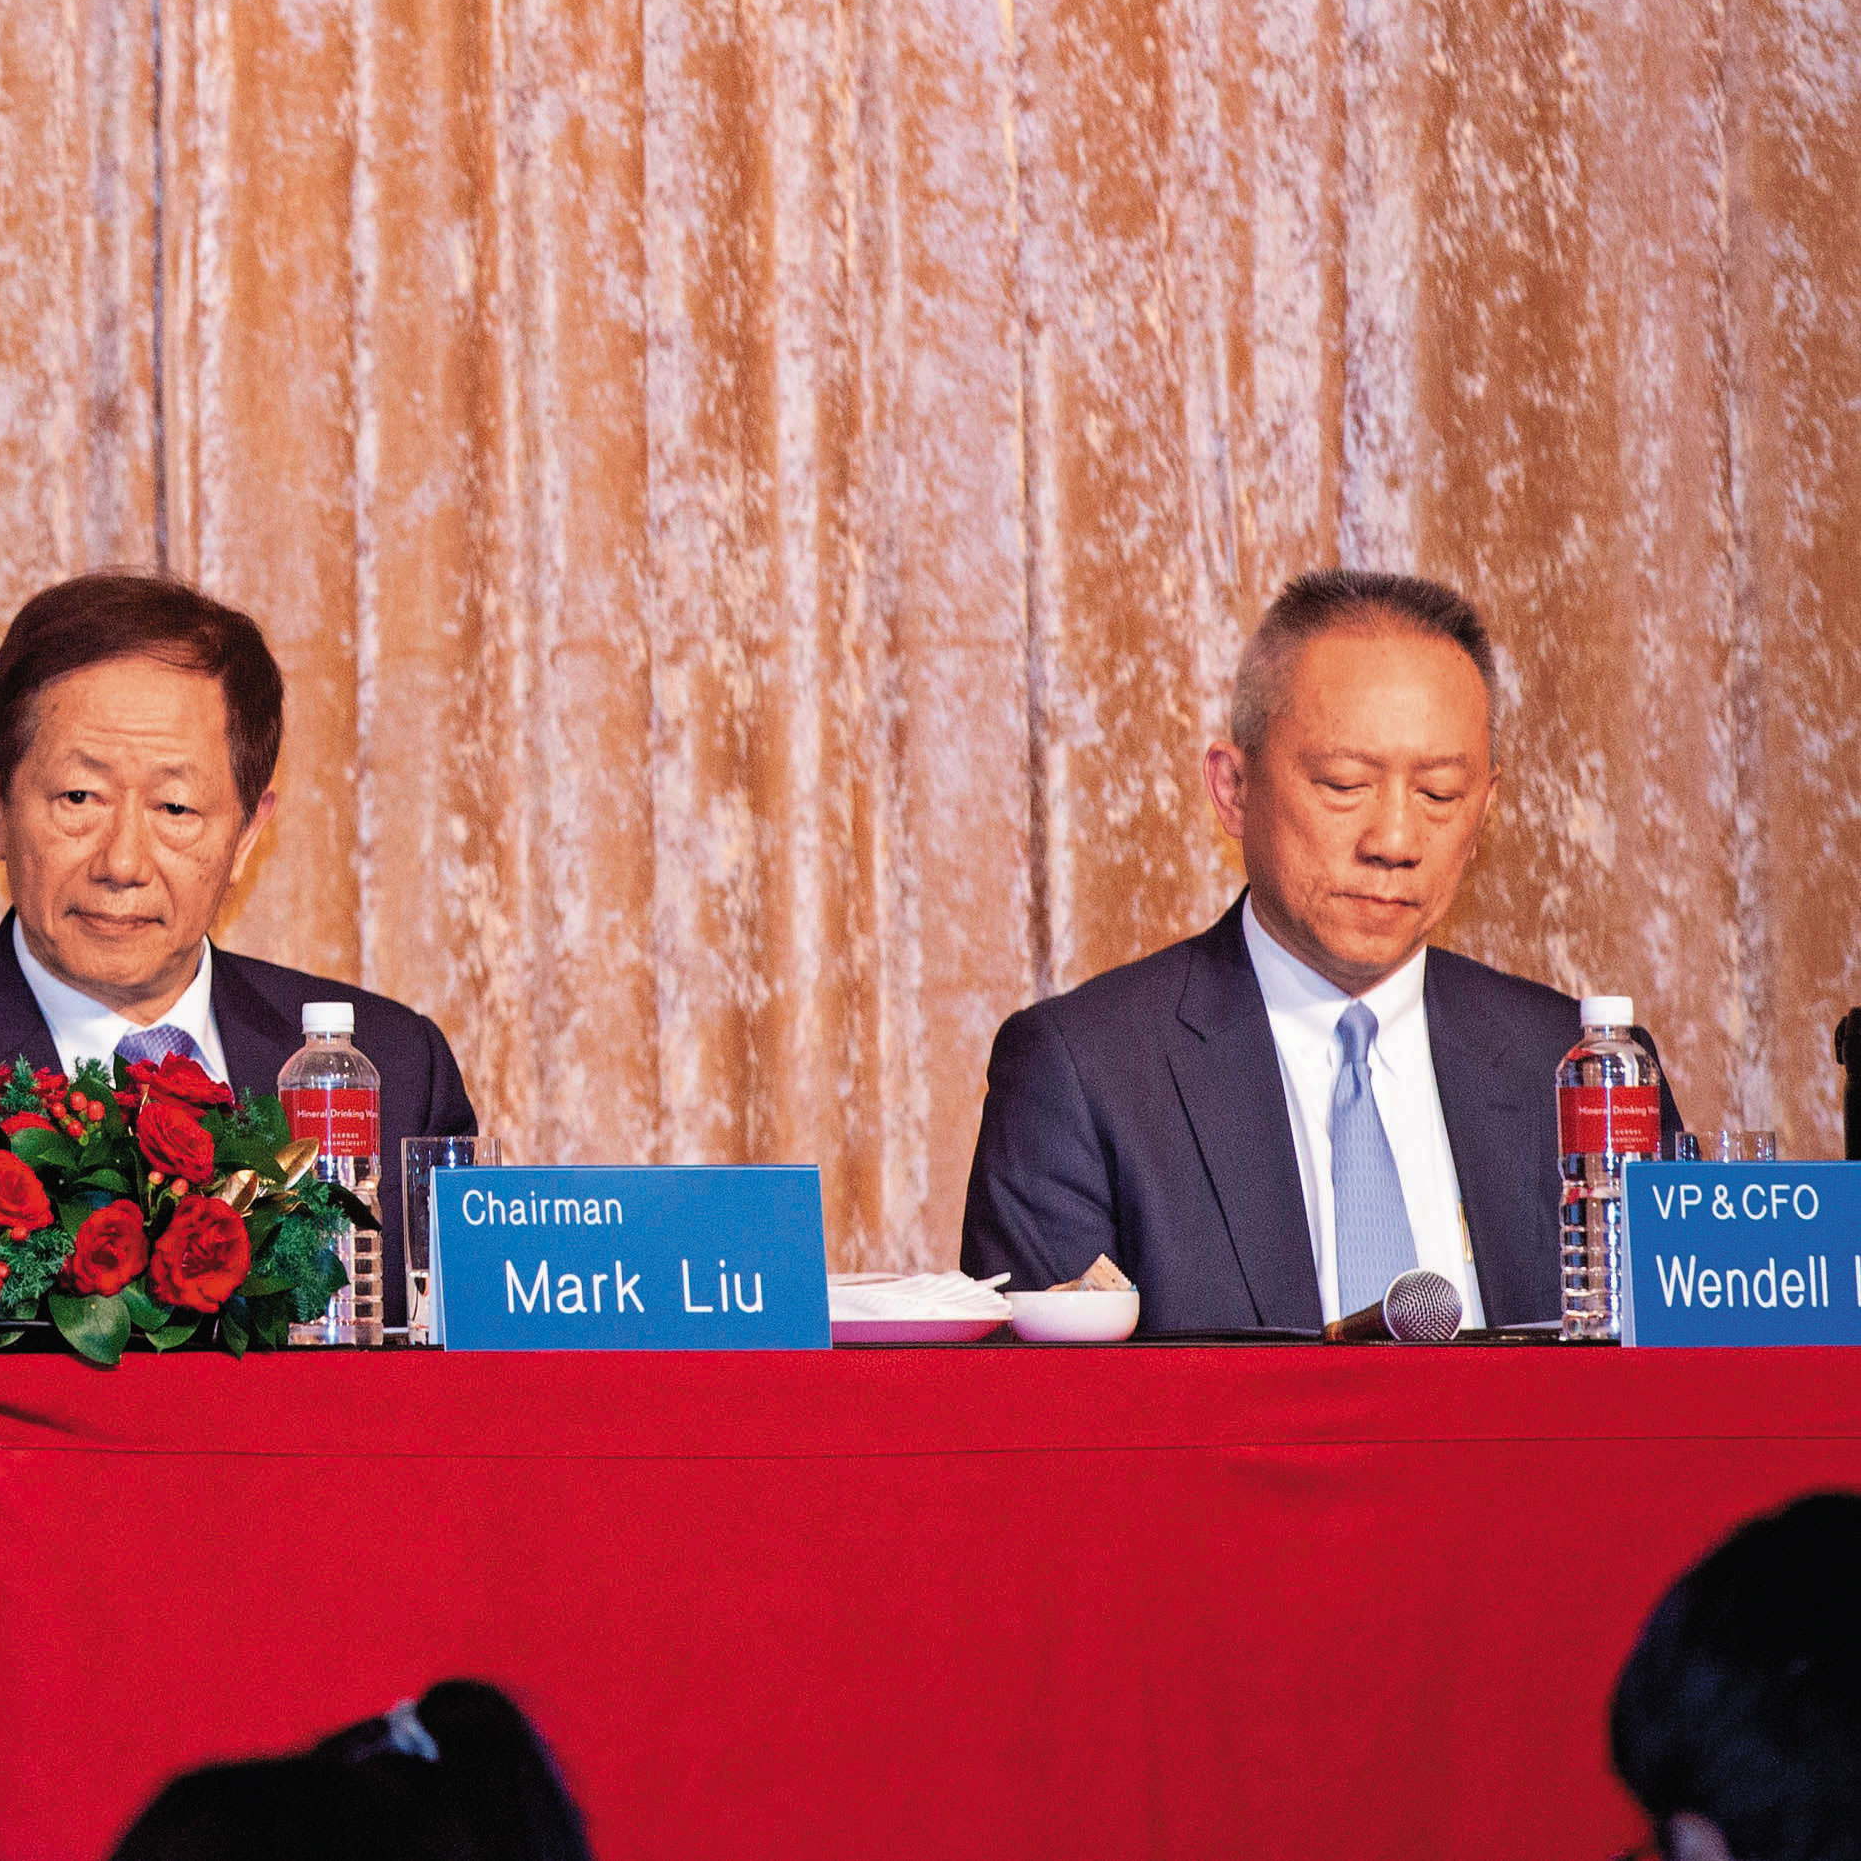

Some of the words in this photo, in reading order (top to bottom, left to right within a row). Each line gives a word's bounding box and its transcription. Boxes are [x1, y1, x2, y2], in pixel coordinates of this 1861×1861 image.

[296, 1109, 328, 1119] Mineral
[330, 1108, 365, 1121] Drinking
[1613, 1105, 1646, 1117] Drinking
[461, 1189, 623, 1226] Chairman
[1652, 1184, 1820, 1221] VP&CFO
[504, 1258, 645, 1314] Mark
[681, 1257, 764, 1314] Liu
[1655, 1253, 1829, 1309] Wendell
